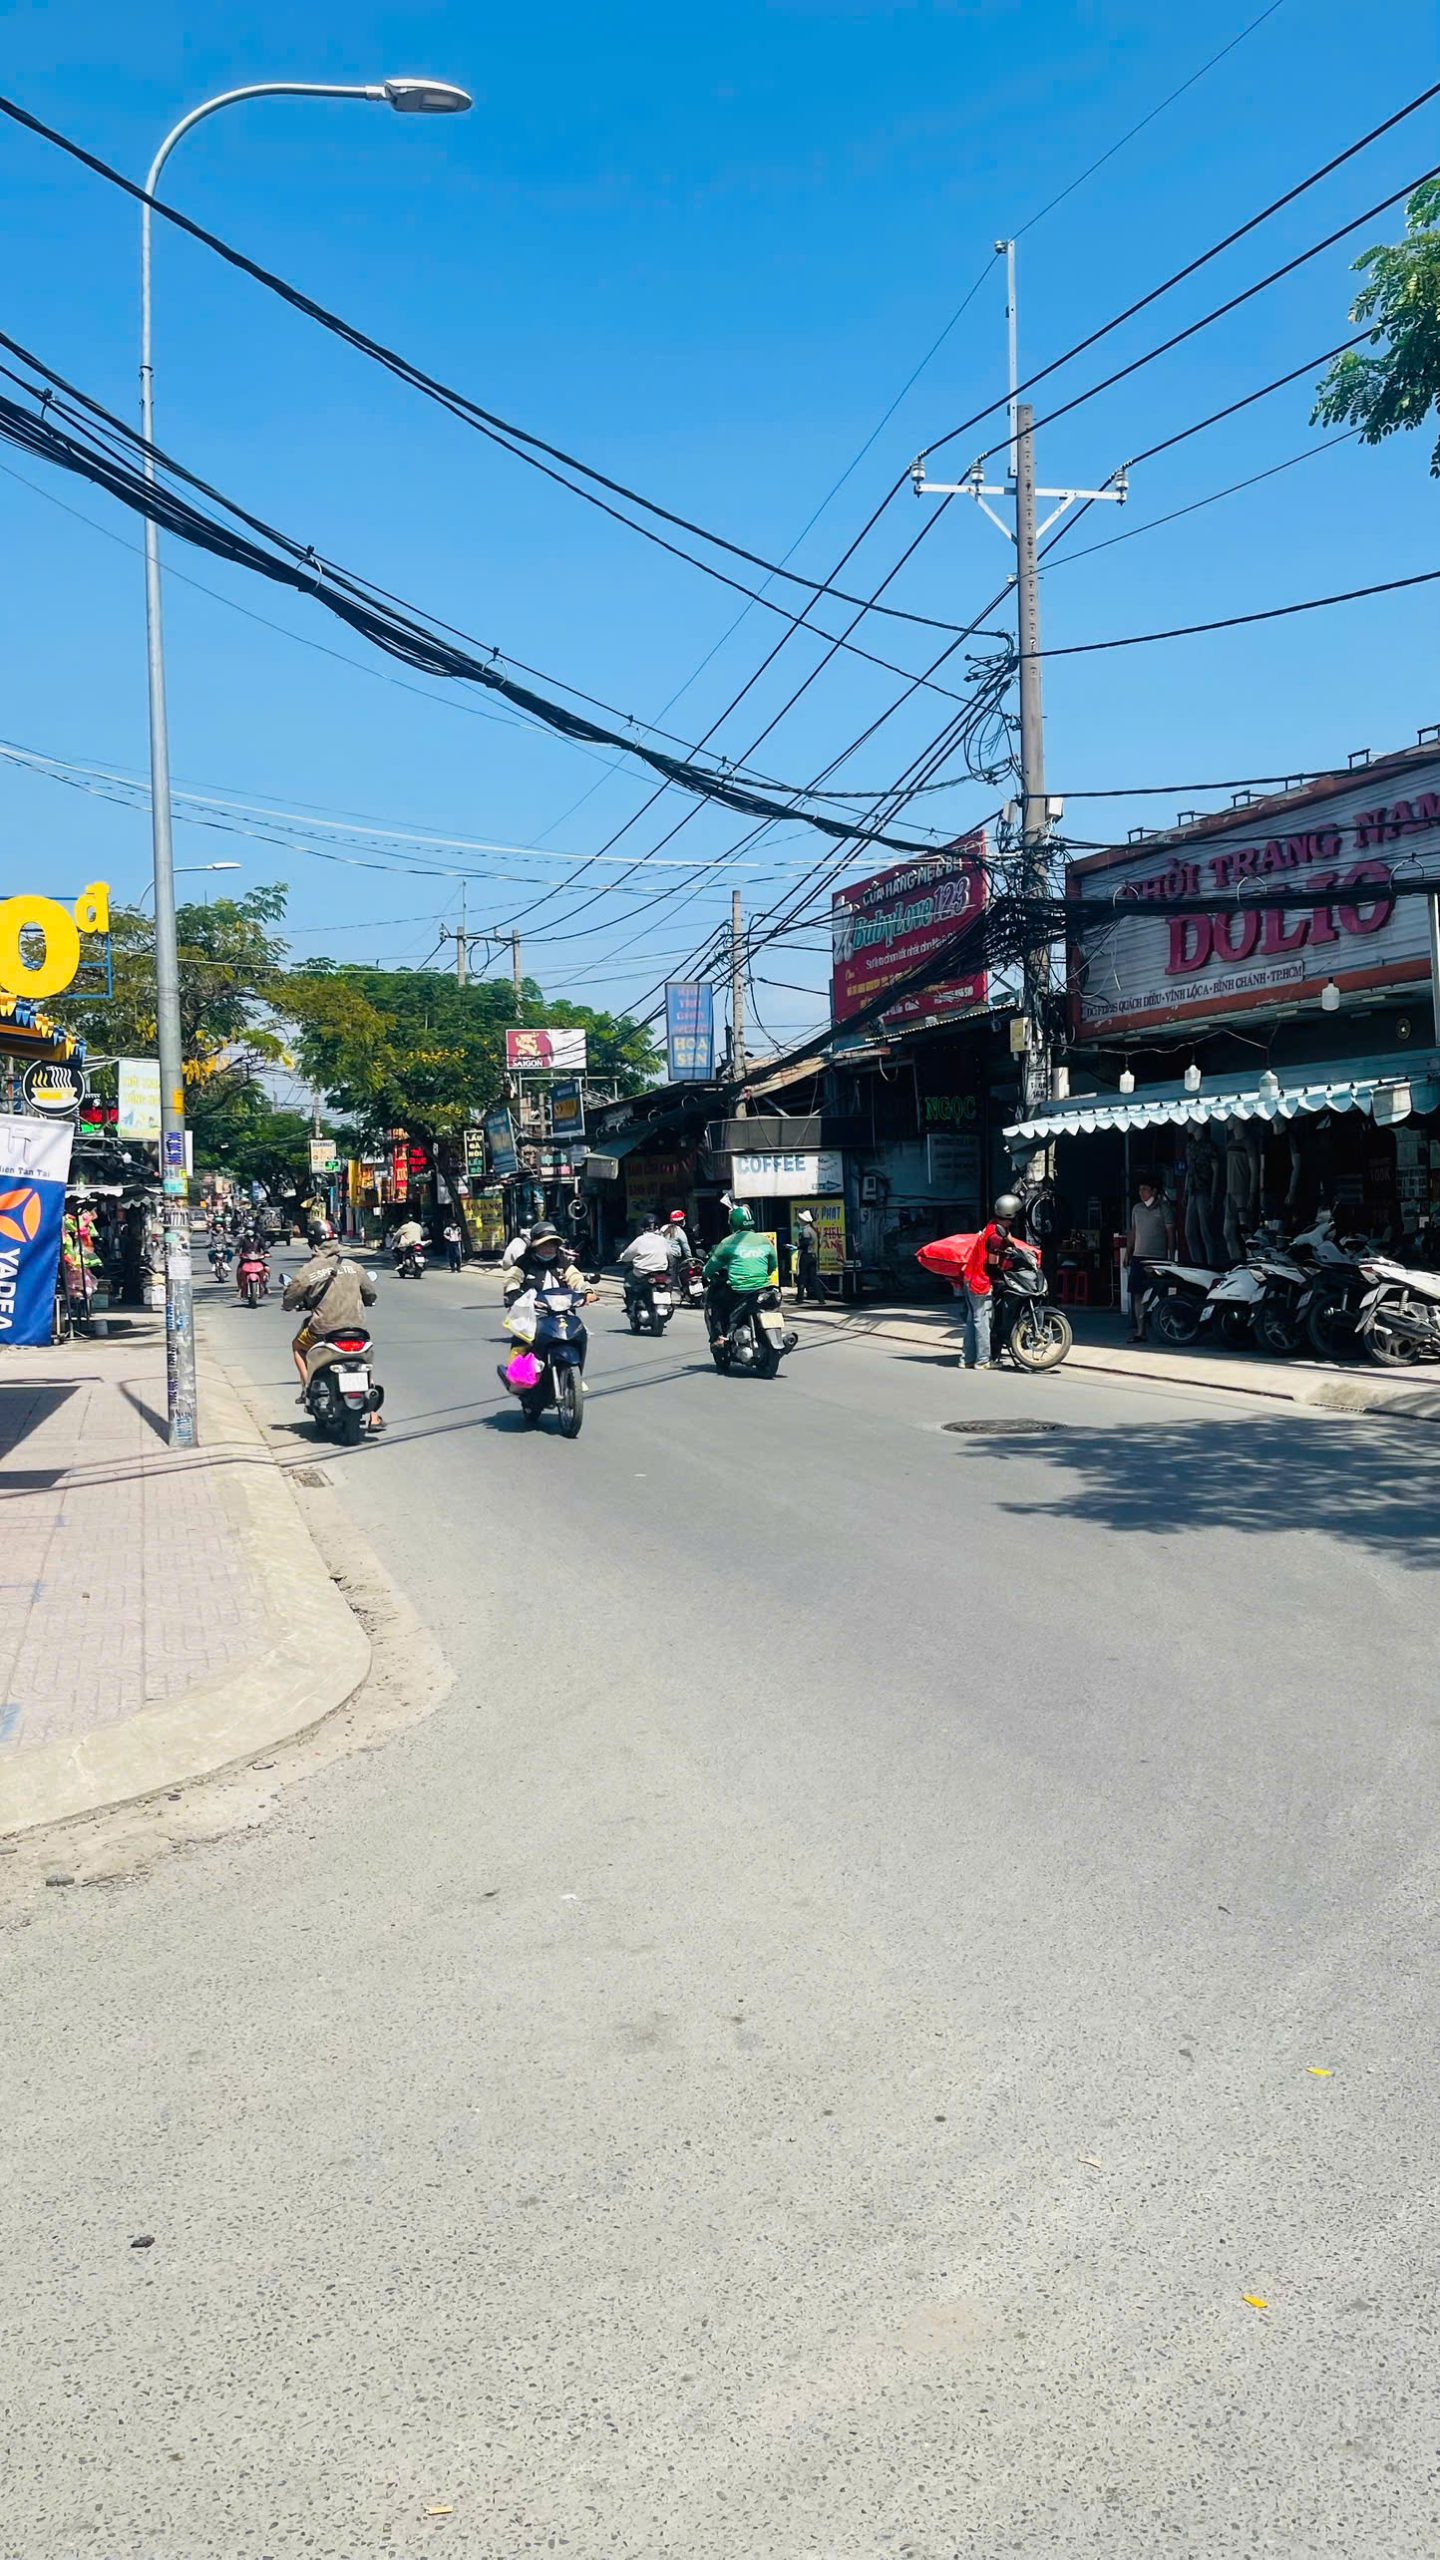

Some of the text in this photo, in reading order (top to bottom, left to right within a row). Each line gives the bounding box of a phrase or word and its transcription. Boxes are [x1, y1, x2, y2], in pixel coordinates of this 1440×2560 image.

[1208, 823, 1343, 888] TRANG
[933, 876, 971, 923] 123
[1165, 860, 1395, 976] DOLIO
[1235, 971, 1267, 989] CHÁNH
[1269, 965, 1303, 983] TP.HCM
[511, 1058, 544, 1068] SAIGON
[924, 1095, 977, 1126] NGỌC
[736, 1154, 806, 1175] COFFEE
